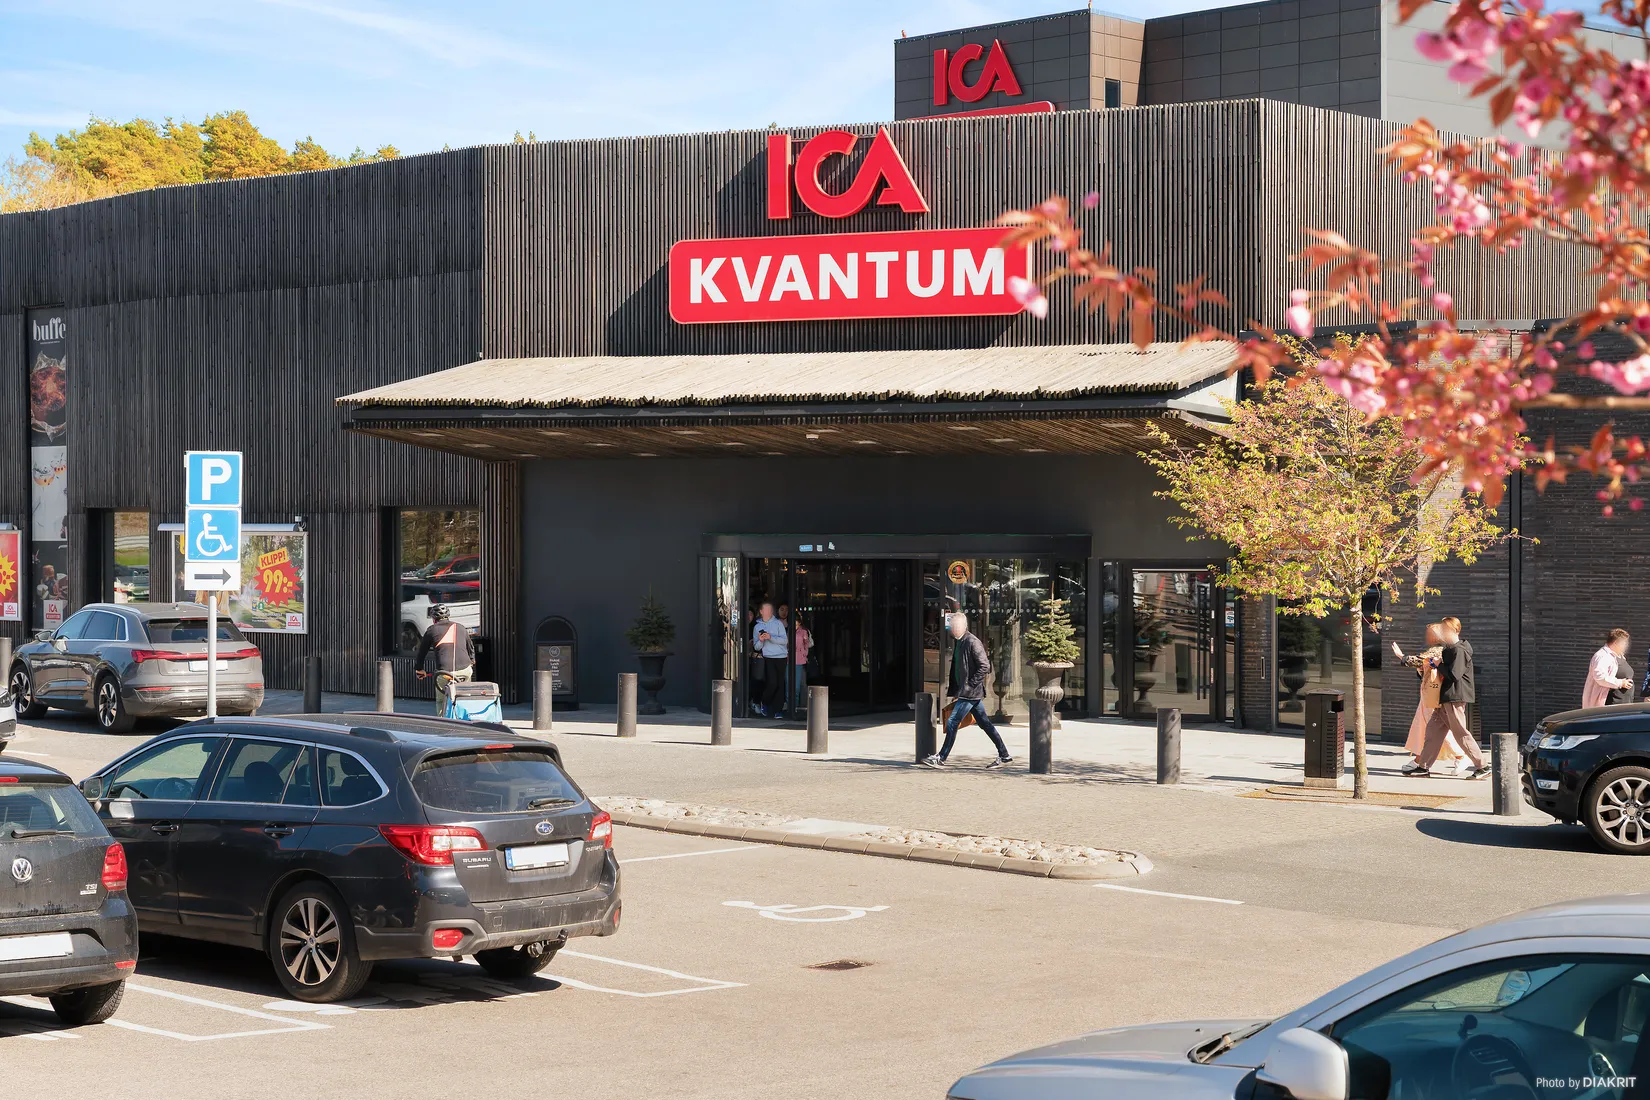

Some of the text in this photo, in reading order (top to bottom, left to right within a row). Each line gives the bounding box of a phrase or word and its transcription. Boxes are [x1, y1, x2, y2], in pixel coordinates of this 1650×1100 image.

[933, 39, 1022, 106] ICA
[767, 125, 930, 220] ICA
[689, 247, 1005, 304] KVANTUM
[201, 458, 232, 501] P
[260, 550, 287, 567] KLIPP!
